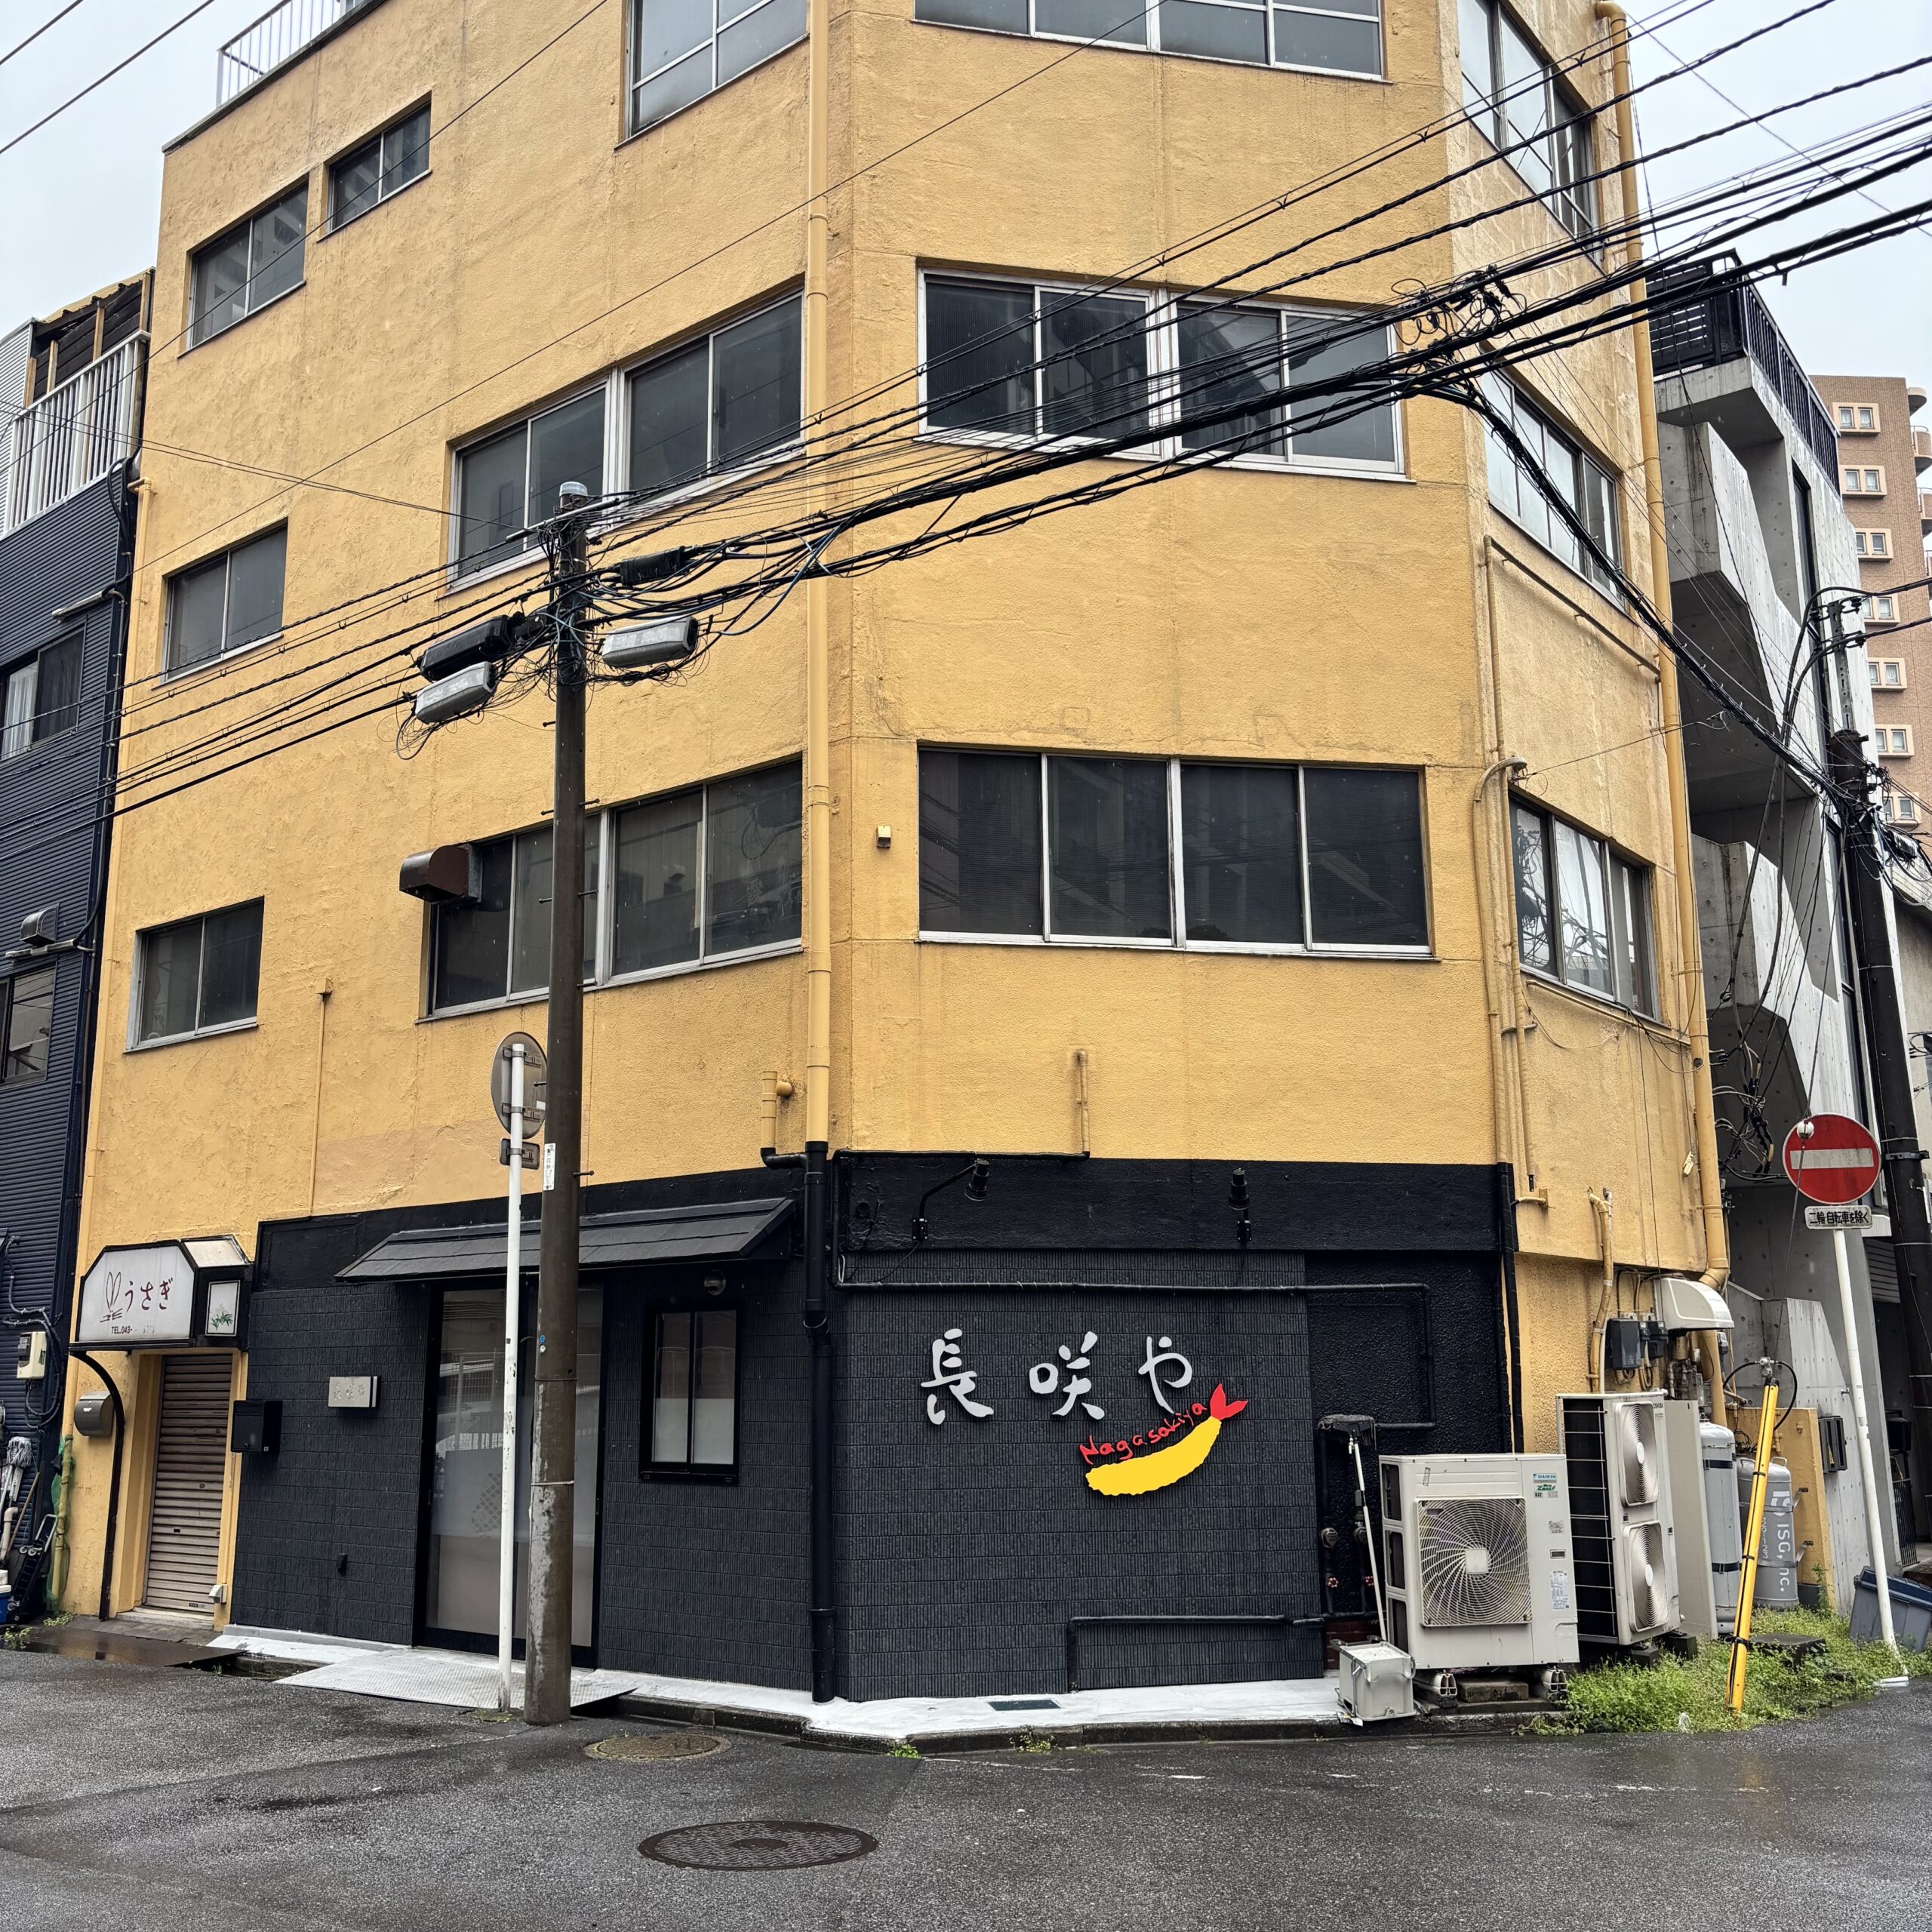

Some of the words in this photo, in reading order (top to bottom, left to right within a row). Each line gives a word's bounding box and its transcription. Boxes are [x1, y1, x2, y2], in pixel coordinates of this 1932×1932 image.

[125, 1277, 174, 1312] うさぎ
[920, 1327, 1193, 1425] 長咲や
[1078, 1401, 1208, 1465] Nagasakiya
[1777, 1523, 1791, 1559] ISG,
[1779, 1567, 1791, 1592] nc.
